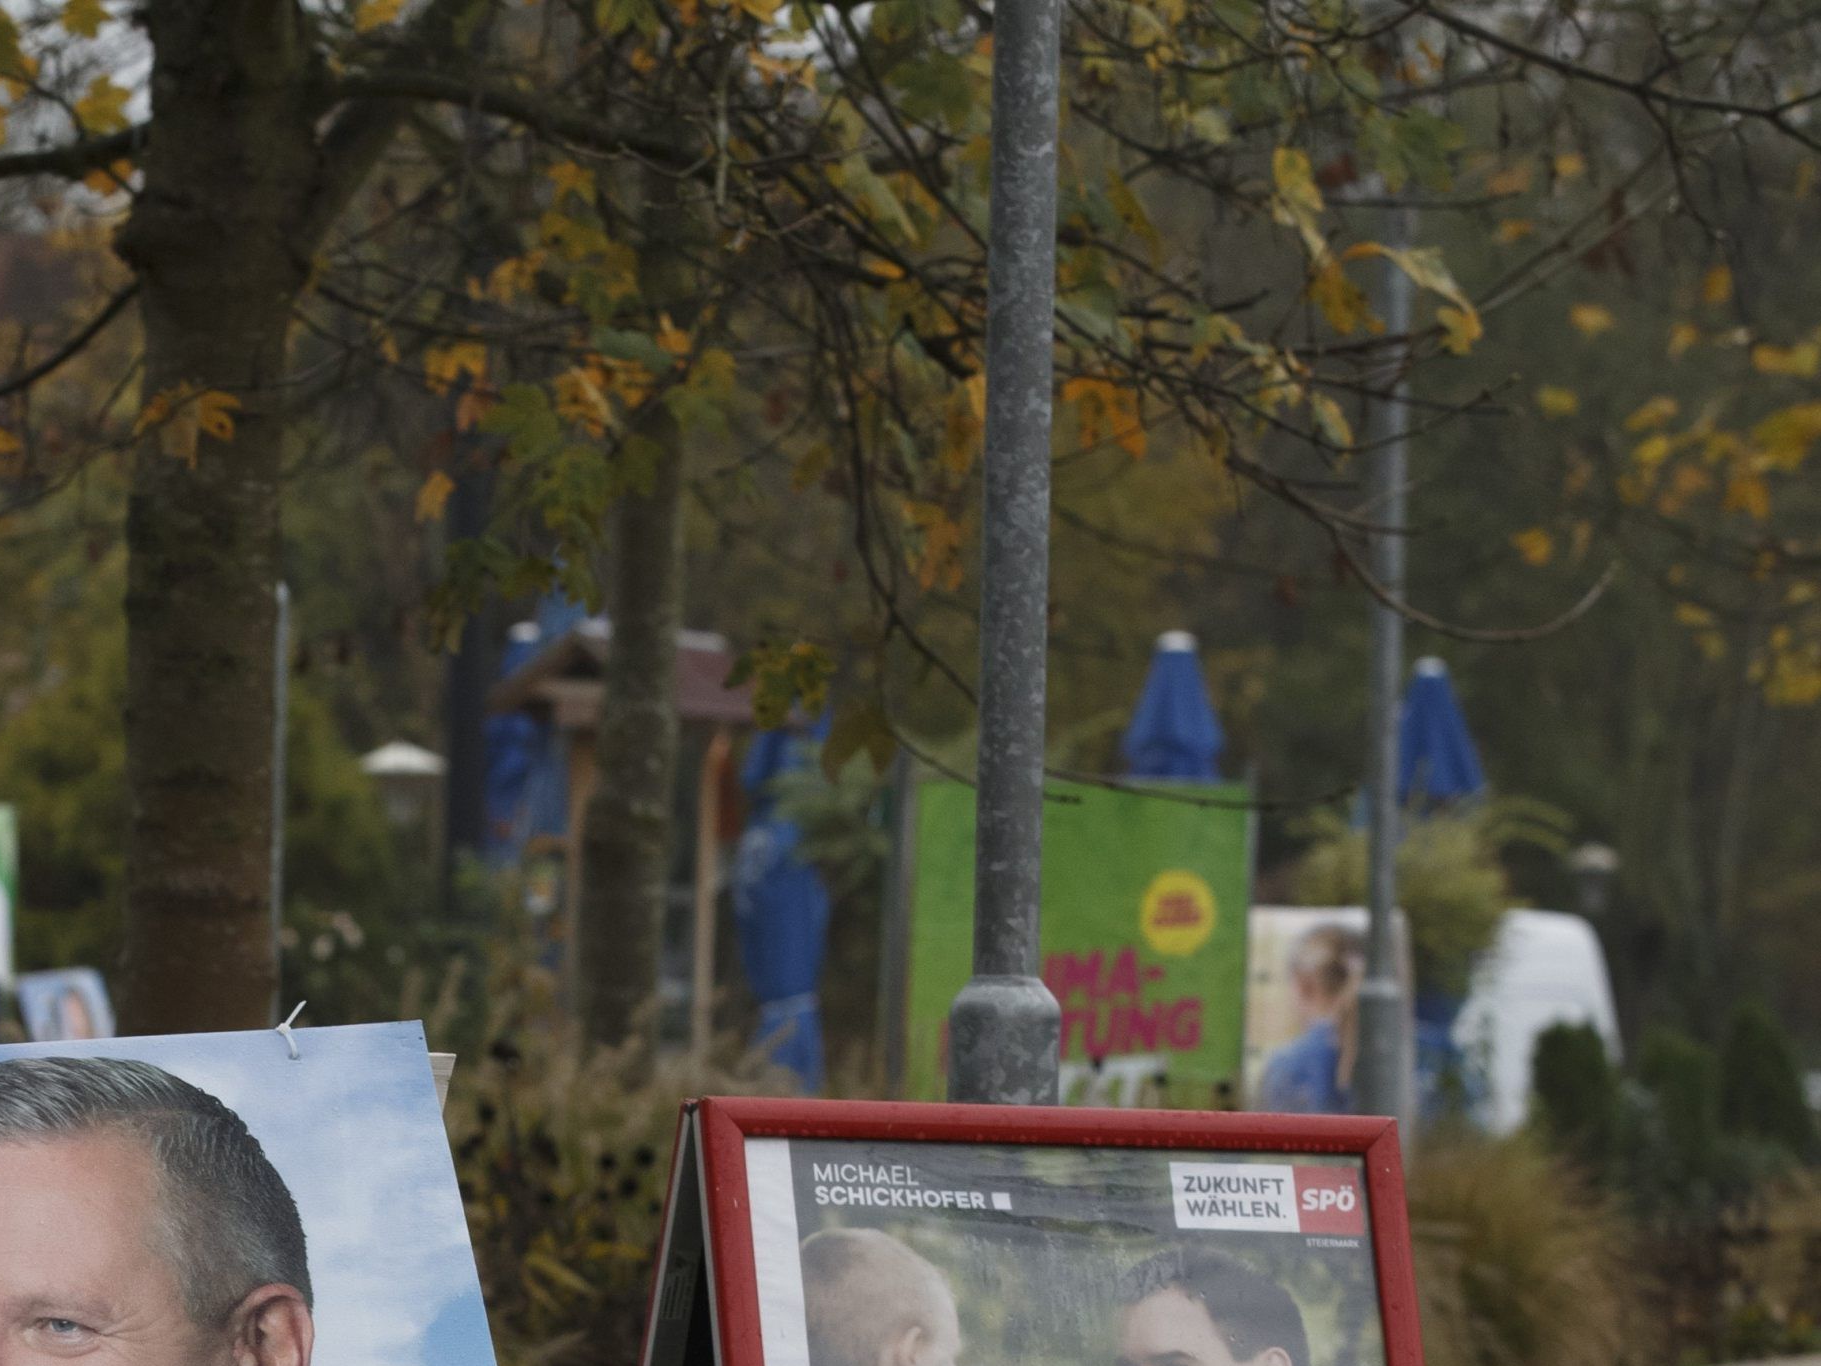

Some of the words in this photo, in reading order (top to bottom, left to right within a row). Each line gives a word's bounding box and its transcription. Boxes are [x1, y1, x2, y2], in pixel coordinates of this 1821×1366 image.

[813, 1163, 920, 1187] MICHAEL
[1183, 1175, 1285, 1195] ZUKUNFT
[814, 1186, 986, 1210] SCHICKHOFER
[1186, 1196, 1288, 1219] WÄHLEN.
[1301, 1186, 1356, 1212] SPÖ
[1306, 1238, 1360, 1249] STEIERMARK
